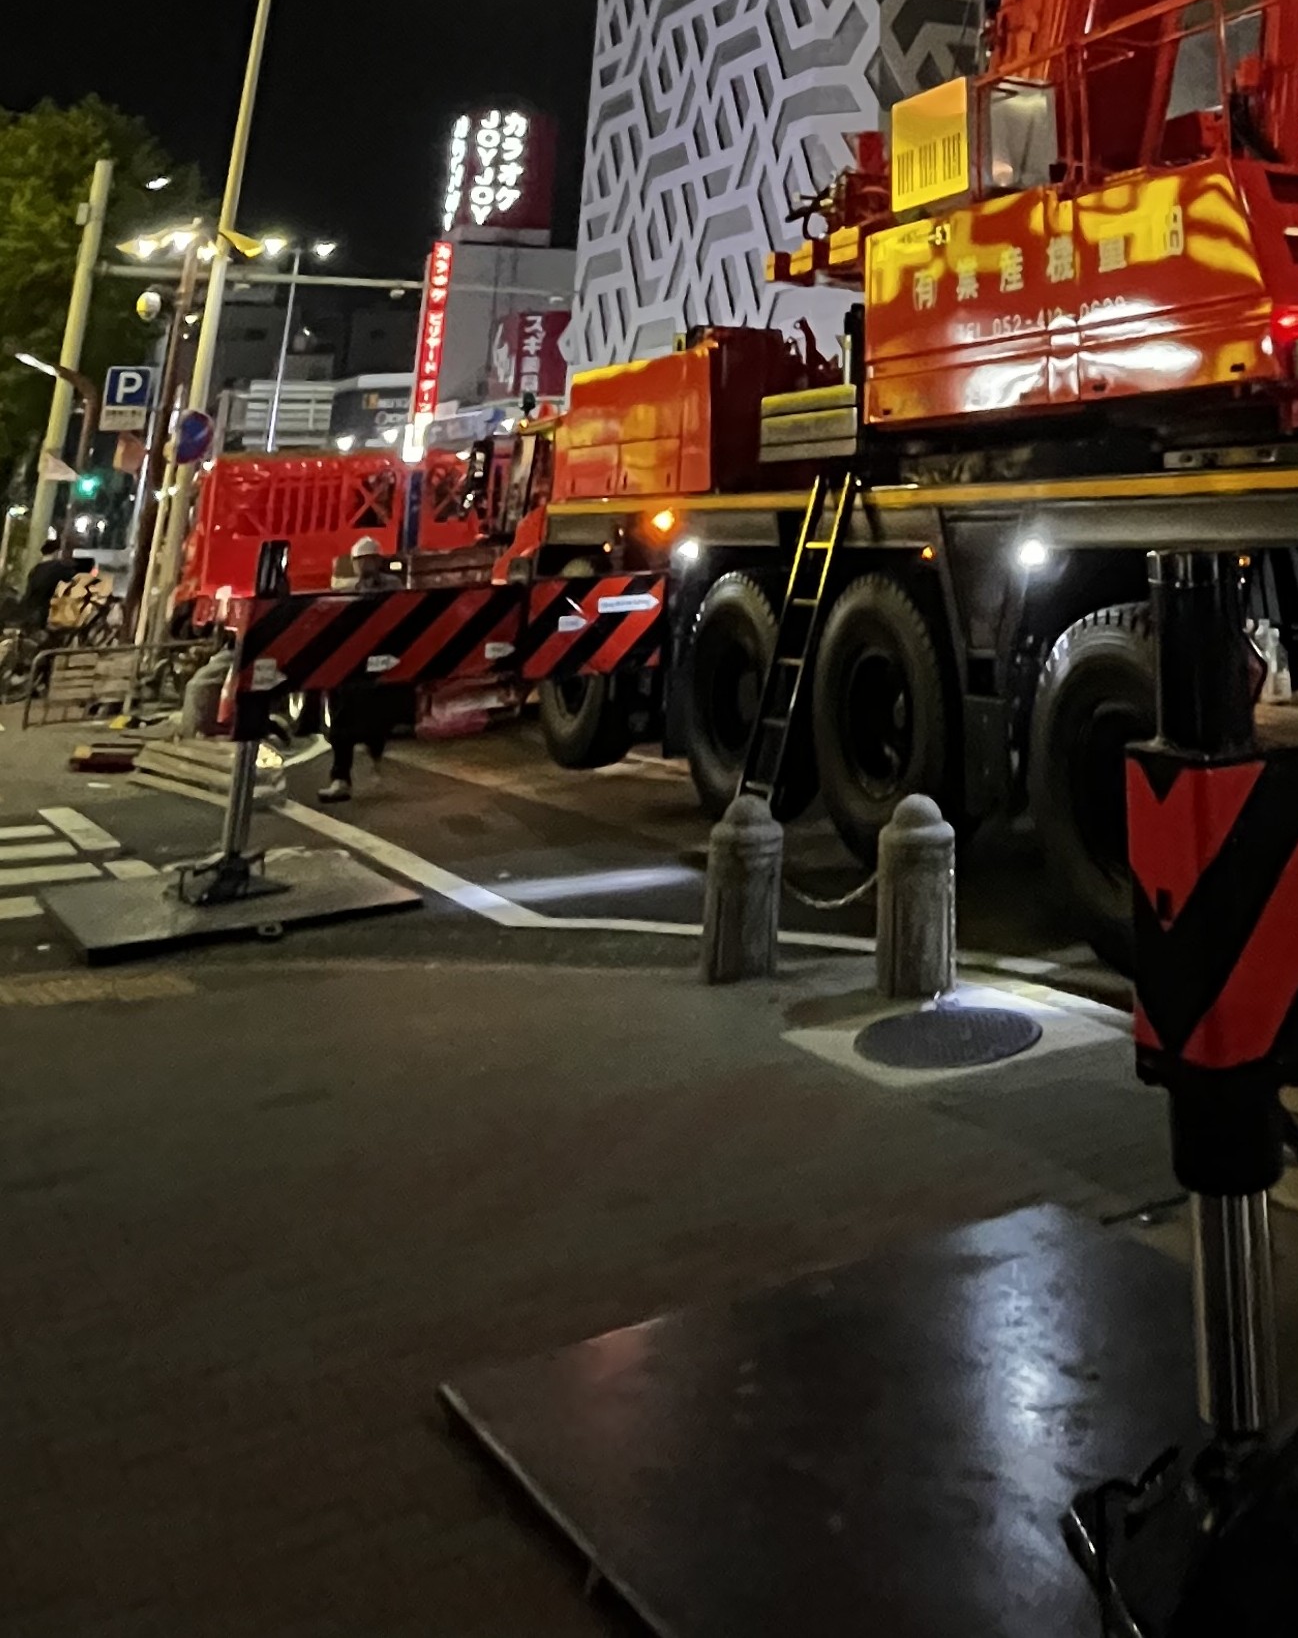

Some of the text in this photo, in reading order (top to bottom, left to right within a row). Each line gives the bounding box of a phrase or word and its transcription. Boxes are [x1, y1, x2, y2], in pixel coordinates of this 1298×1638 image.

[495, 111, 528, 212] カラオケ
[115, 371, 143, 404] P
